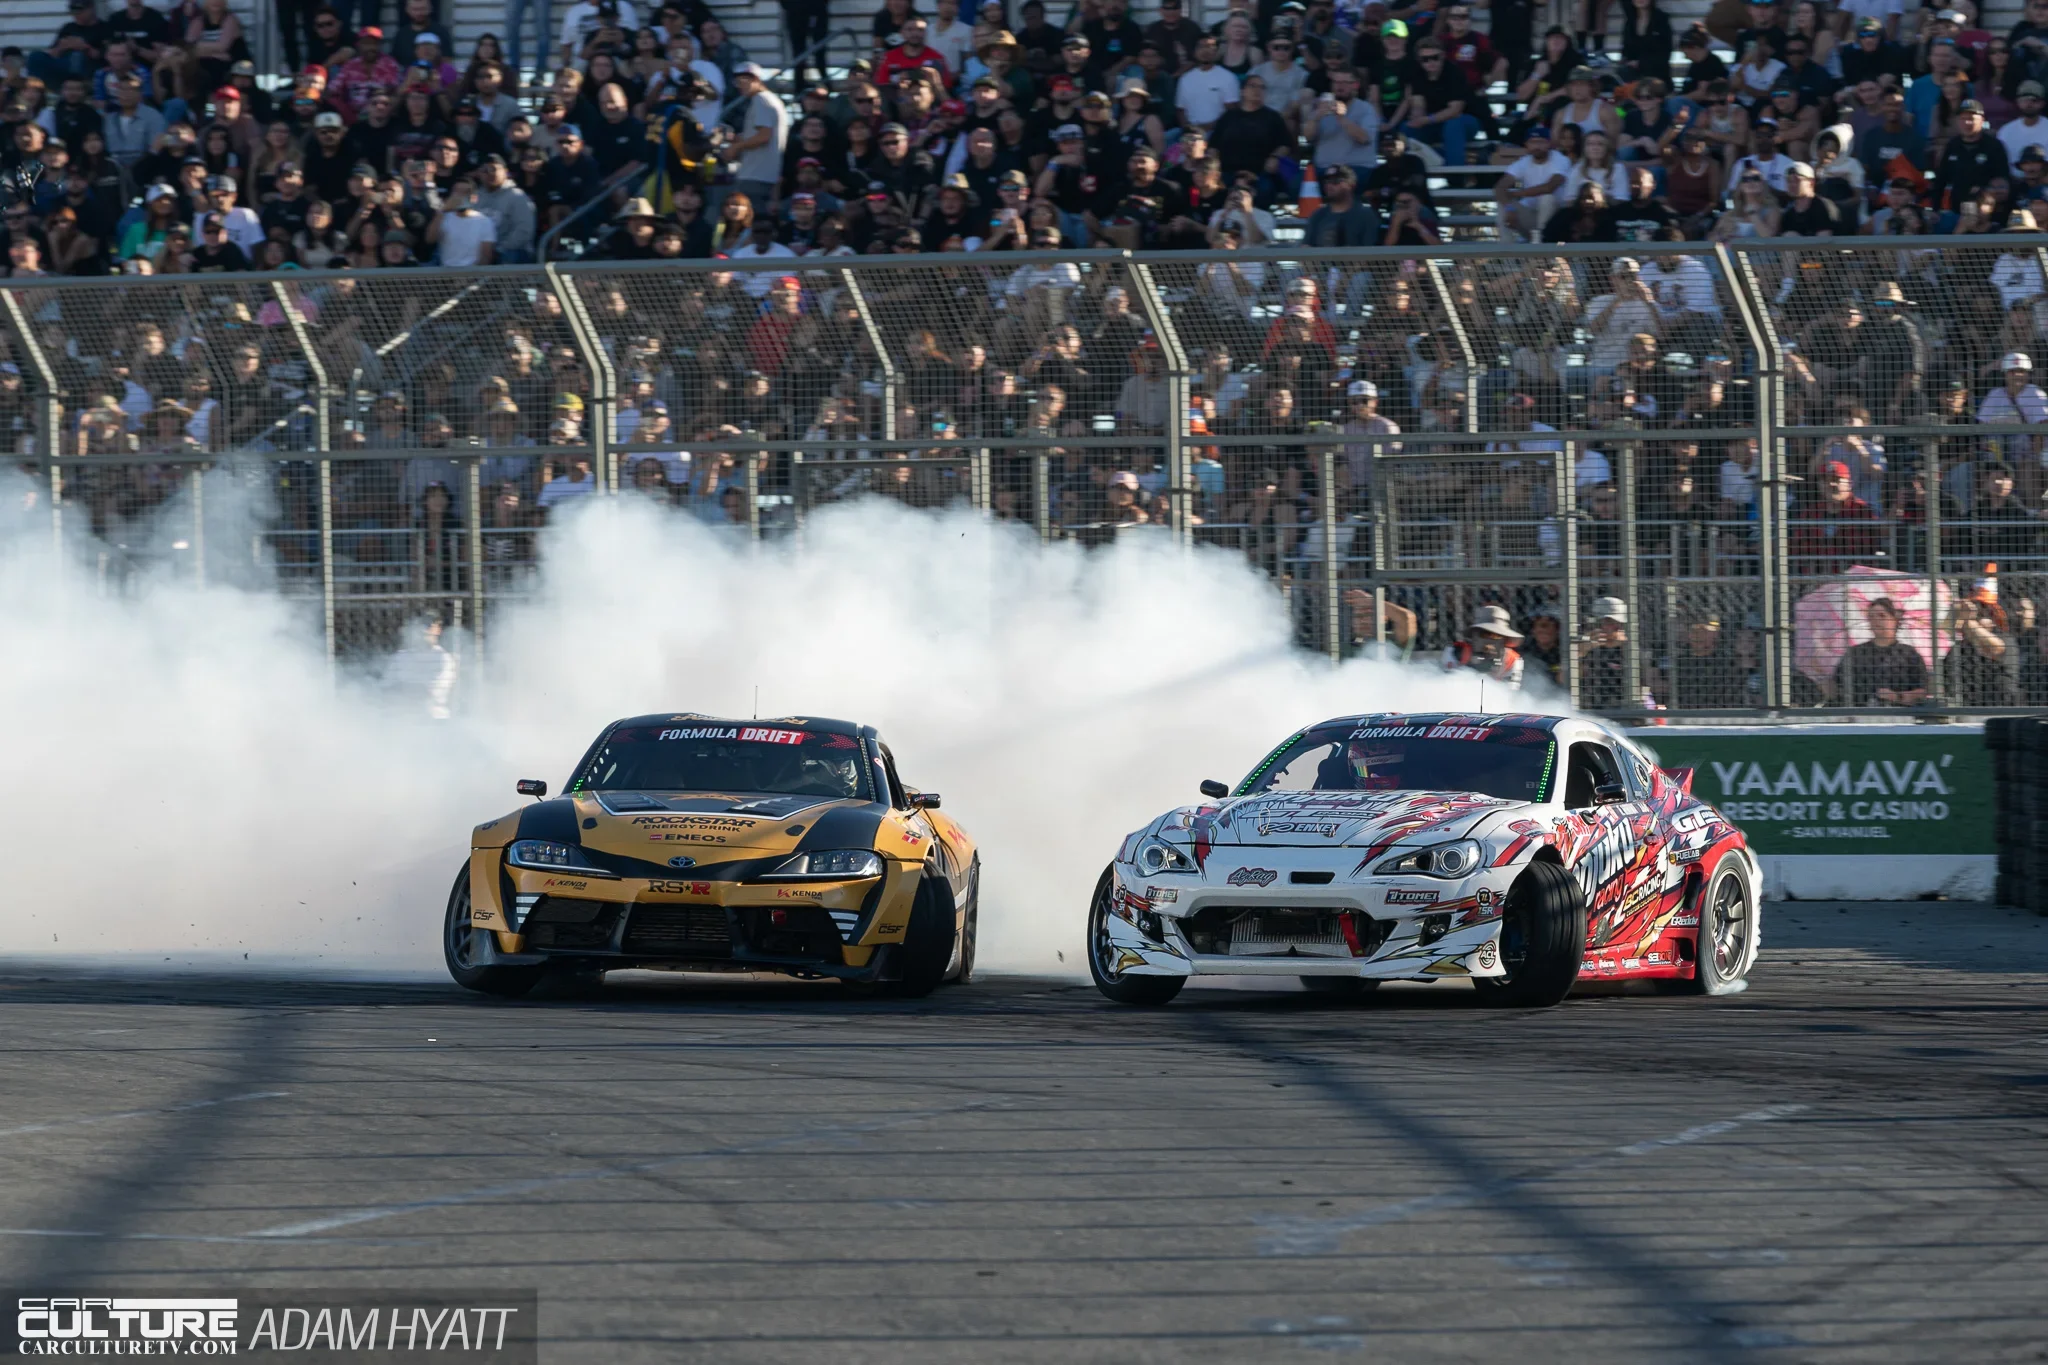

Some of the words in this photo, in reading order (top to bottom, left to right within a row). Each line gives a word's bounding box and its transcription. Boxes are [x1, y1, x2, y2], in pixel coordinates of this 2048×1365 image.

[659, 727, 737, 741] FORMULA
[741, 727, 801, 744] DRIFT
[1349, 726, 1426, 740] FORMULA
[1427, 726, 1489, 741] DRIFT
[1721, 801, 1822, 821] RESORT
[1827, 801, 1845, 820] &
[1850, 801, 1949, 821] CASINO
[631, 816, 757, 828] ROCKSTAR
[698, 824, 741, 832] DRINK
[664, 833, 727, 843] ENEOS
[1675, 850, 1700, 861] FUELAB
[557, 880, 588, 888] KENDA
[1638, 873, 1662, 902] RACING
[792, 890, 823, 898] KENDA
[1399, 892, 1438, 900] TOMEI
[473, 911, 496, 921] CSF
[878, 925, 905, 934] CSF
[1480, 949, 1496, 959] ACL
